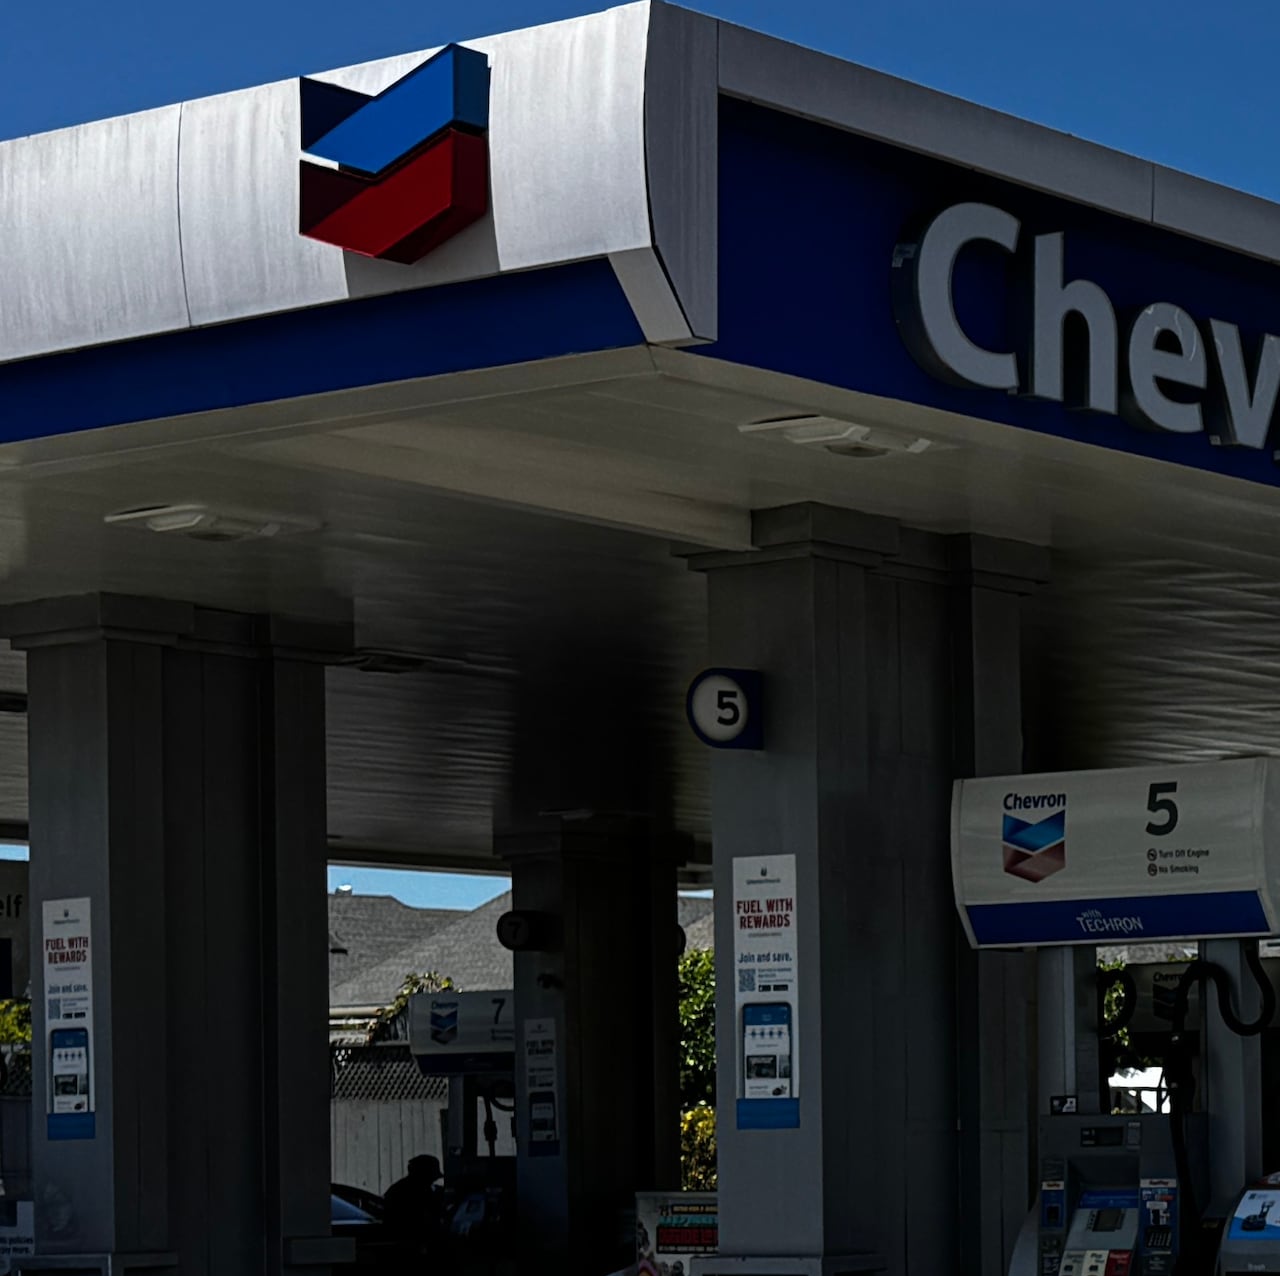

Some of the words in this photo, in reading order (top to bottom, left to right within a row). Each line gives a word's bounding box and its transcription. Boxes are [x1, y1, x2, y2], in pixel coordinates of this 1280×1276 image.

[718, 691, 739, 725] 5
[1004, 792, 1066, 810] Chevron
[1145, 782, 1178, 836] 5
[1170, 864, 1199, 875] Smoking
[736, 899, 763, 915] FUEL
[765, 897, 793, 913] WITH
[739, 914, 791, 930] REWARDS
[45, 937, 67, 951] FUEL
[68, 935, 89, 949] WITH
[48, 950, 87, 964] REWARDS
[756, 952, 771, 963] and
[491, 998, 505, 1025] 7
